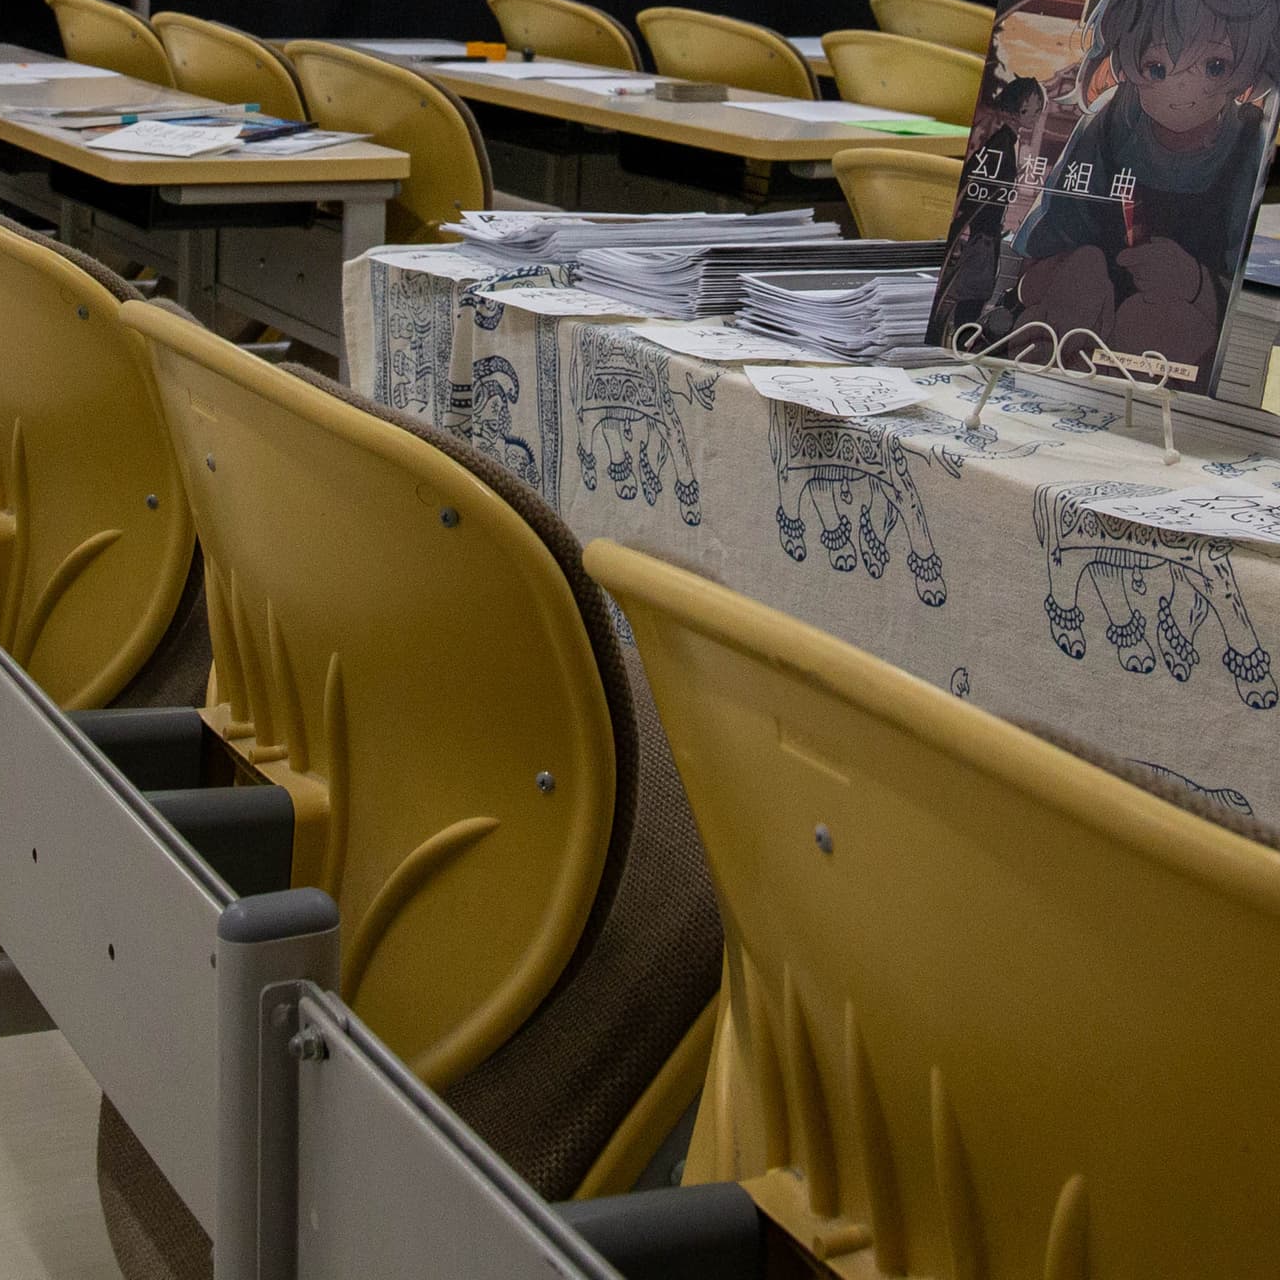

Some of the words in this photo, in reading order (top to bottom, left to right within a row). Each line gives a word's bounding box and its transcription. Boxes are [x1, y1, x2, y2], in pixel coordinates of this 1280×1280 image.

[971, 145, 1137, 201] 幻想組曲
[966, 182, 992, 201] Op.
[996, 187, 1019, 204] 20
